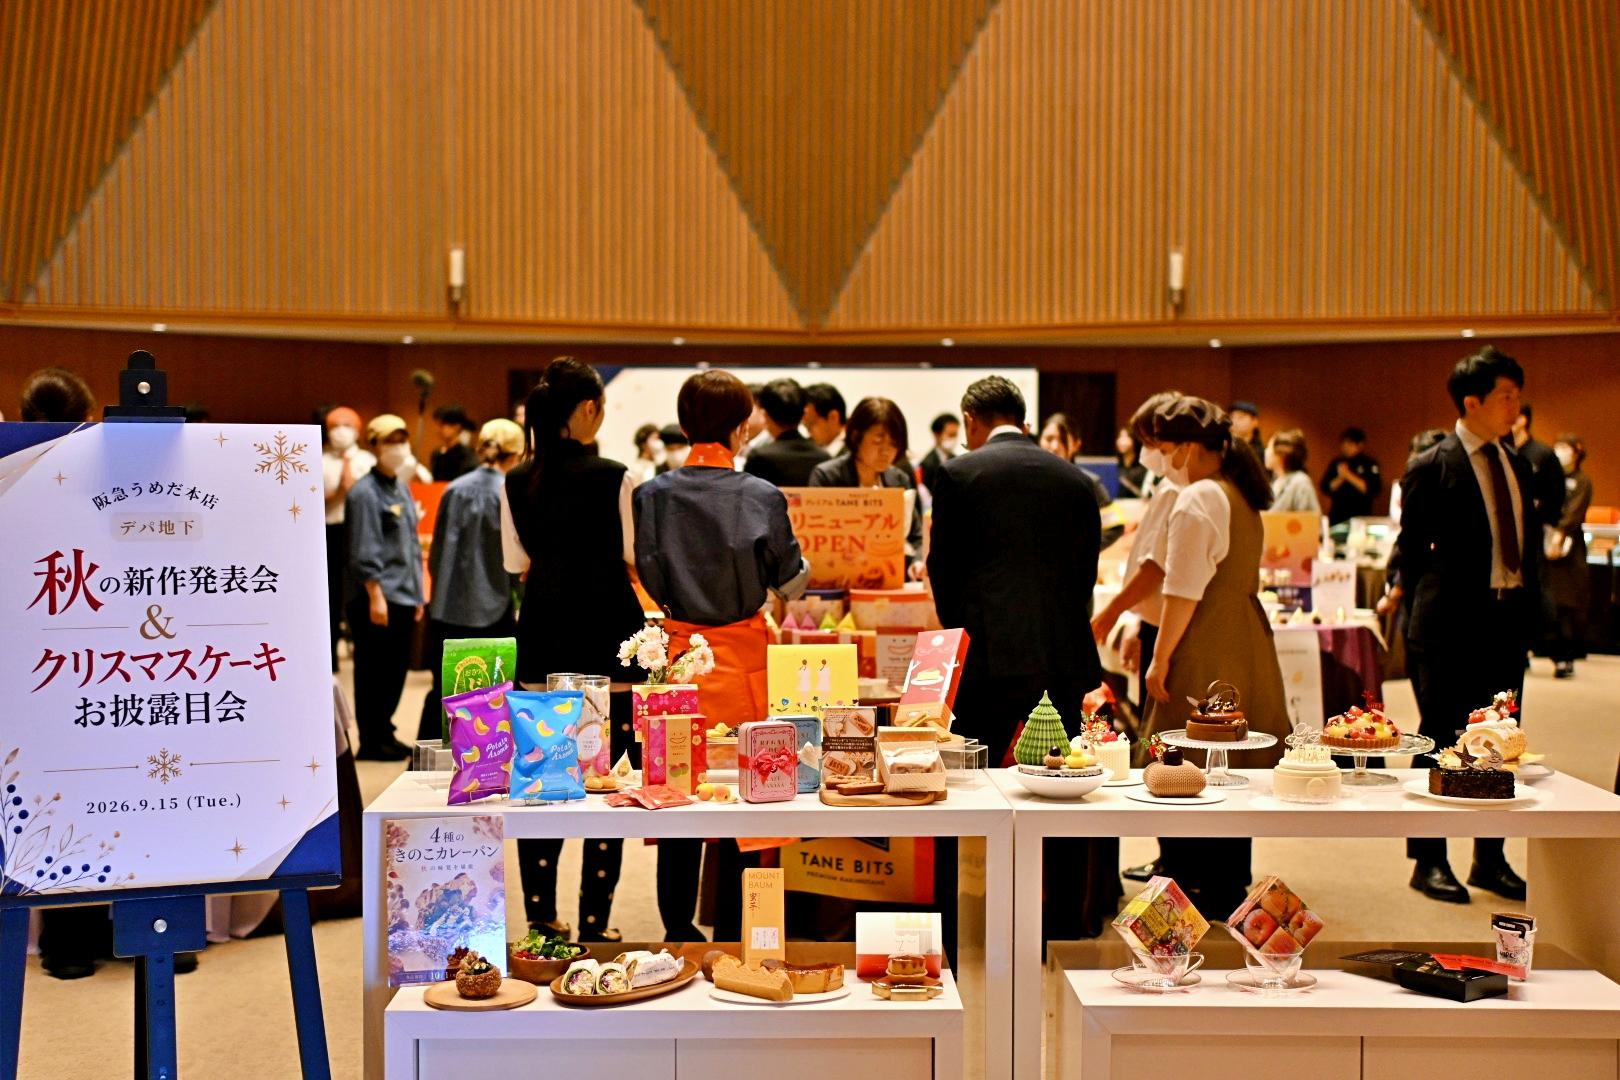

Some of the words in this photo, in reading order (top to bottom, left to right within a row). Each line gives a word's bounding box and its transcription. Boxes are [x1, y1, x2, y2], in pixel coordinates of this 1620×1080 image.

[91, 481, 220, 511] 阪急うめだ本店
[120, 519, 195, 536] デパ地下
[793, 513, 900, 531] リニューアル
[26, 549, 280, 616] 秋の新作発表会
[139, 604, 178, 640] &
[31, 642, 287, 693] クリスマスケーキ
[74, 690, 248, 728] お披露目会
[86, 796, 179, 814] 2026.9.15
[187, 792, 242, 810] (Tue.)
[430, 826, 465, 843] 4種の
[395, 844, 499, 863] きのこカレーパン
[800, 851, 844, 871] TANE
[854, 859, 894, 875] BITS
[748, 881, 773, 889] BAUM
